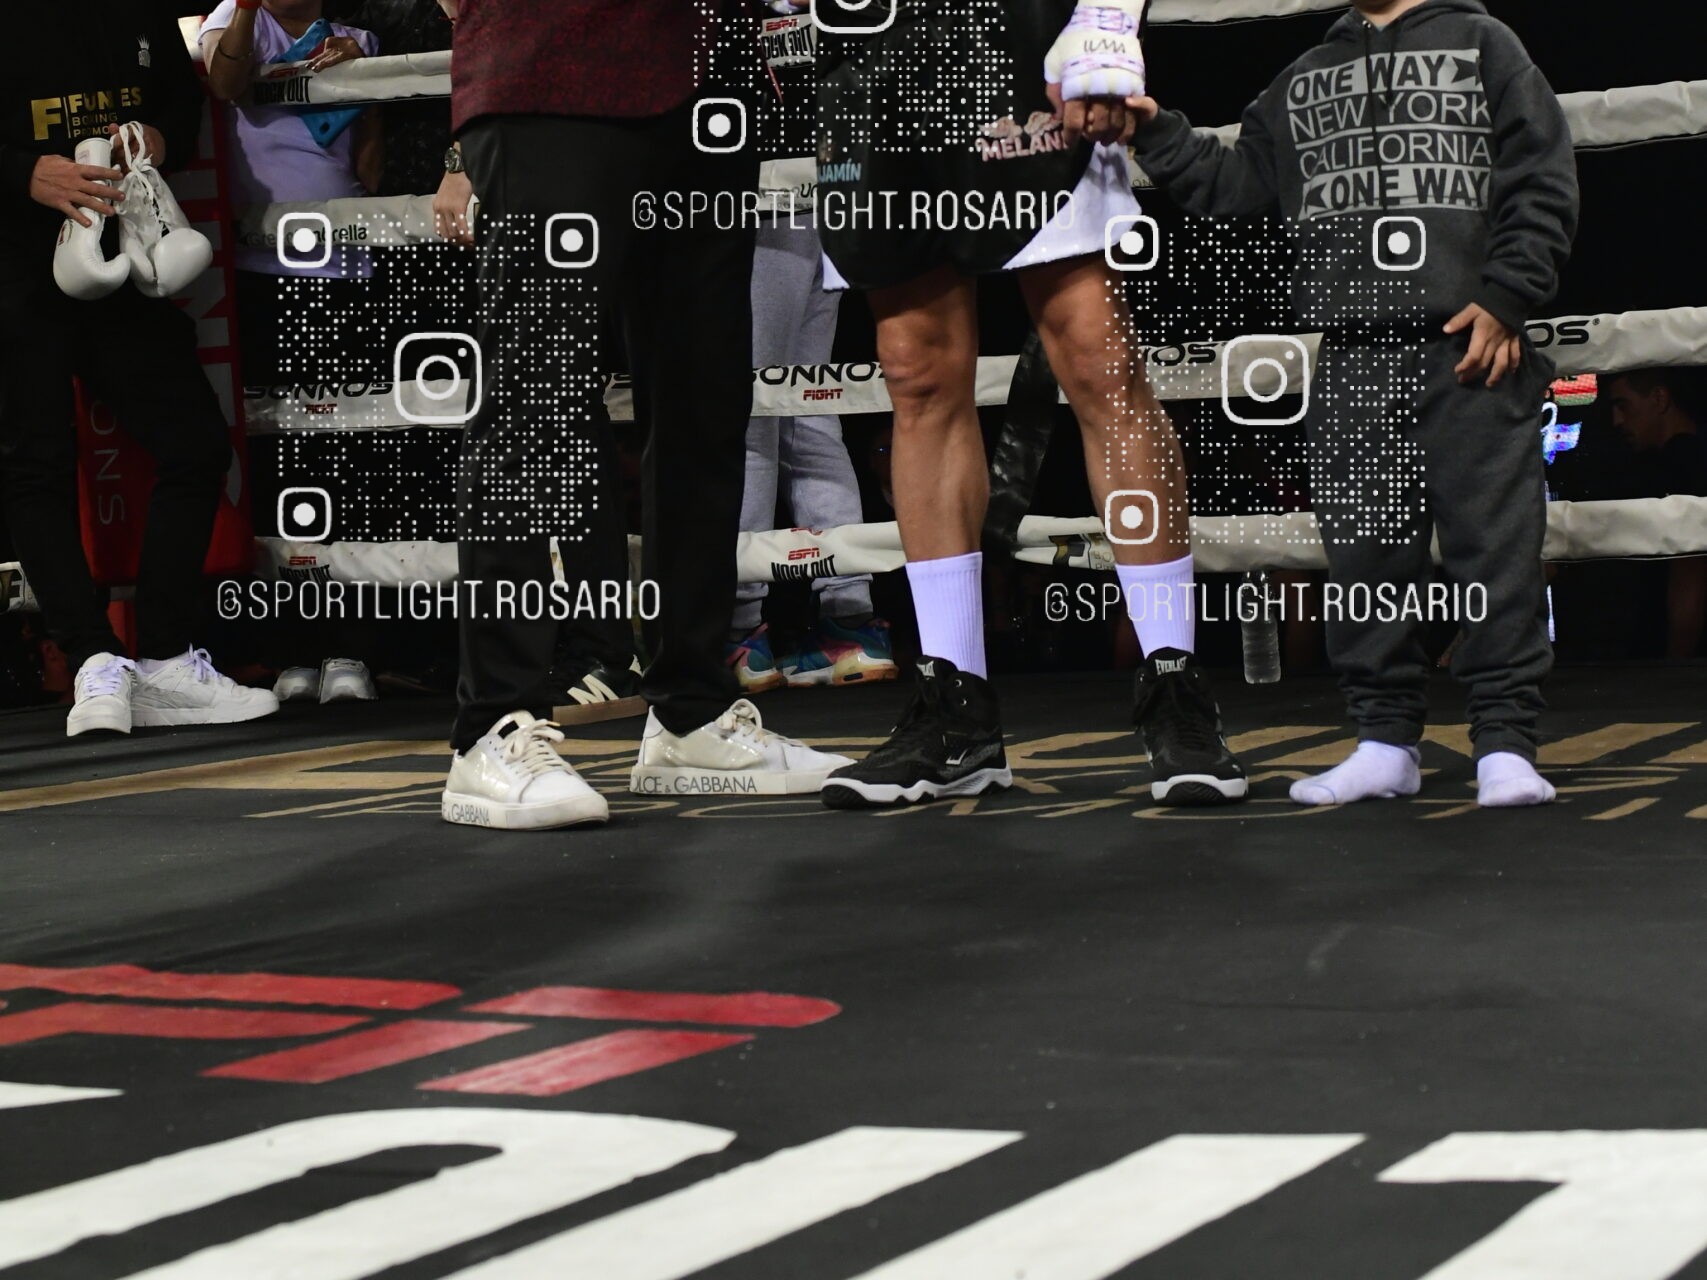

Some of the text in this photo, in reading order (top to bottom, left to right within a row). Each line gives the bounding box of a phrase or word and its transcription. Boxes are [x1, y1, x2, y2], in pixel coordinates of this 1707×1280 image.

[1290, 54, 1447, 105] ONE WAY
[68, 86, 143, 113] FUNES
[1289, 91, 1492, 143] NEW YORK
[1300, 132, 1493, 180] CALIFORNIA
[818, 157, 862, 183] JAMÍN
[1330, 167, 1490, 211] ONE WAY
[803, 388, 844, 401] FIGHT
[288, 556, 317, 566] ESPN
[788, 547, 820, 561] ESPN
[673, 775, 758, 794] GABBANA
